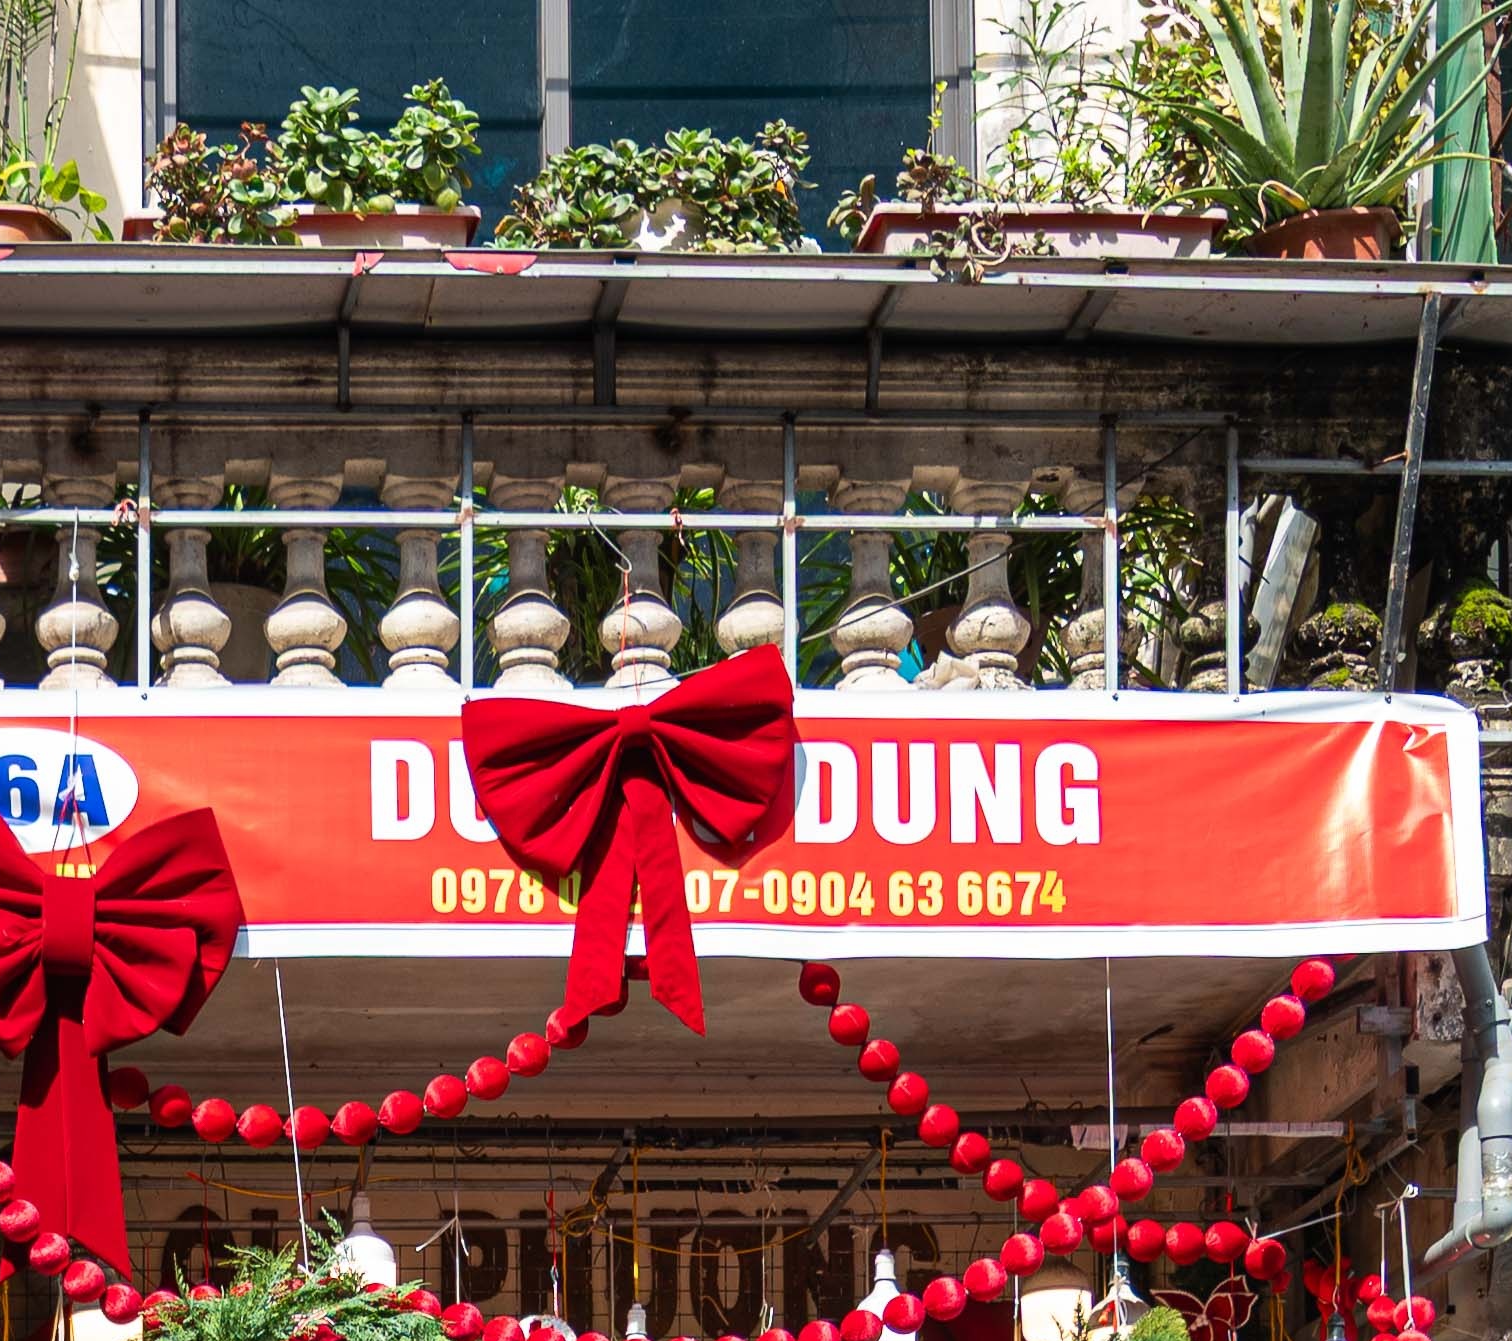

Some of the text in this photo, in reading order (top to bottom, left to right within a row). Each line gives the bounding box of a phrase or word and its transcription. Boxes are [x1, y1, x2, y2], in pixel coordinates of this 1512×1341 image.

[793, 741, 1100, 845] DUNG
[431, 869, 545, 914] 0978
[887, 871, 943, 916] 63
[966, 871, 1067, 916] 6674
